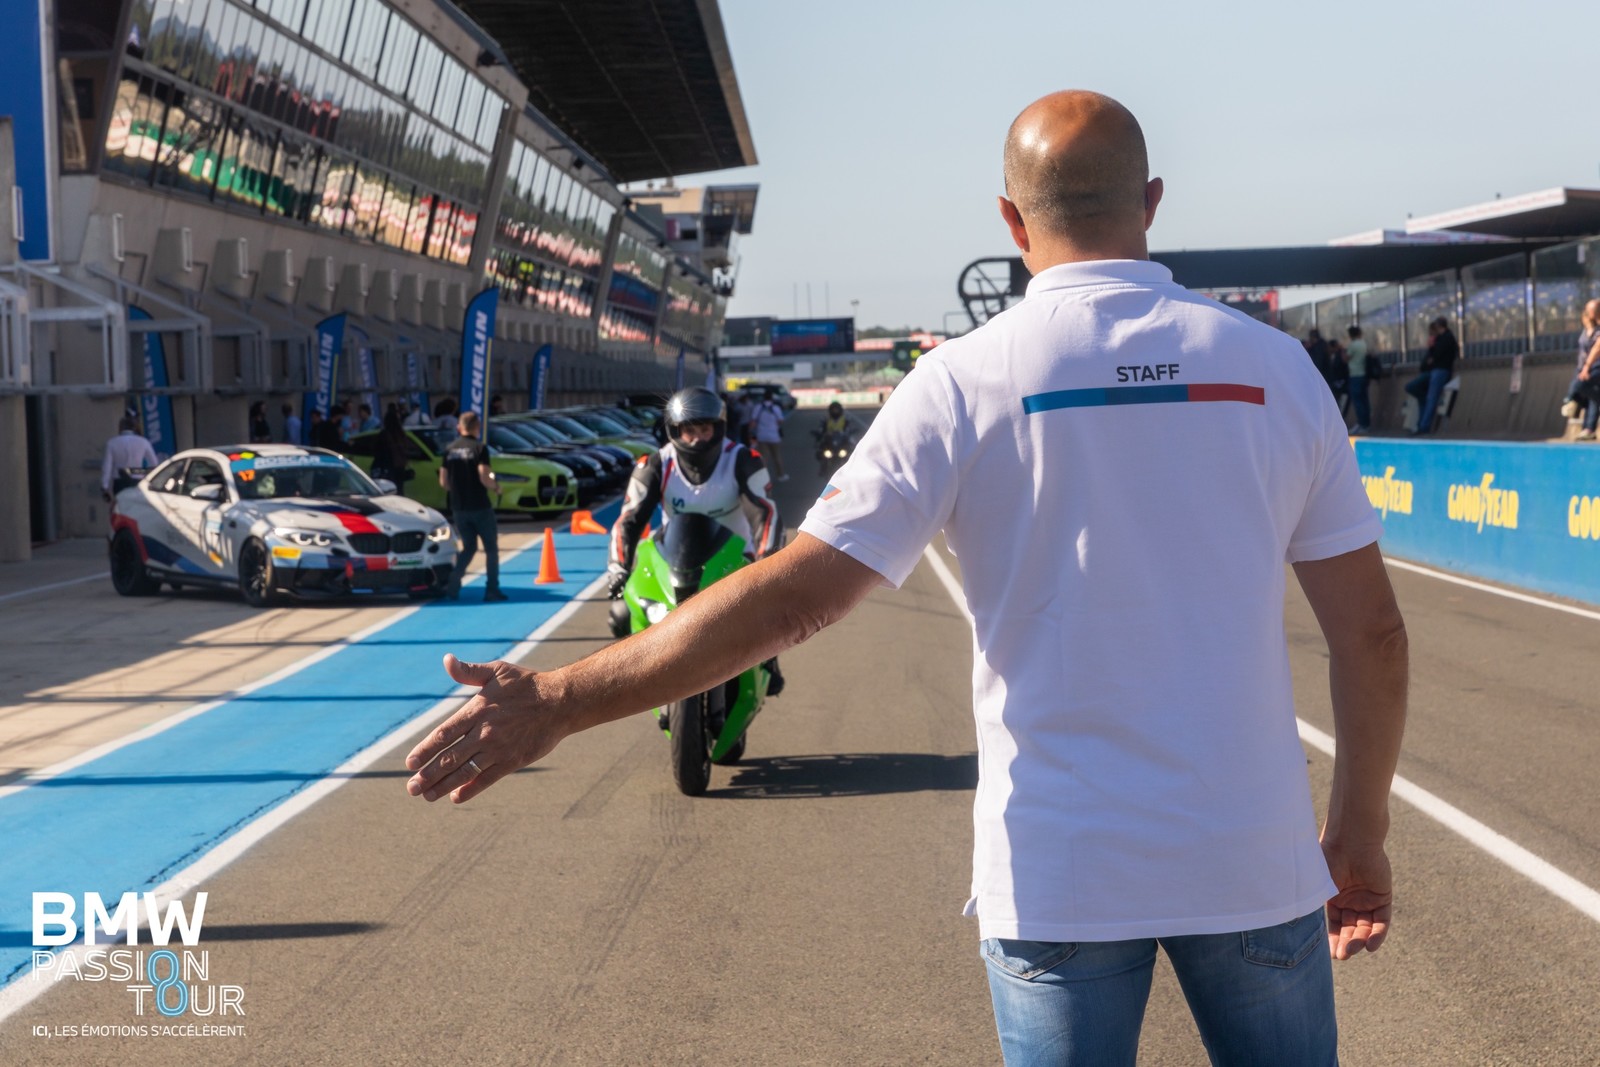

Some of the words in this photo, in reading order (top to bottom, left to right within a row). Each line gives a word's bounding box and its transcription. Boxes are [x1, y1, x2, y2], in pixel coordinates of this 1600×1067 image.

[316, 332, 334, 420] ICHELIN
[470, 310, 488, 421] ICHELIN
[1116, 363, 1180, 383] STAFF
[1361, 466, 1413, 521] OODYEAR
[1447, 472, 1519, 534] GOODYEAR
